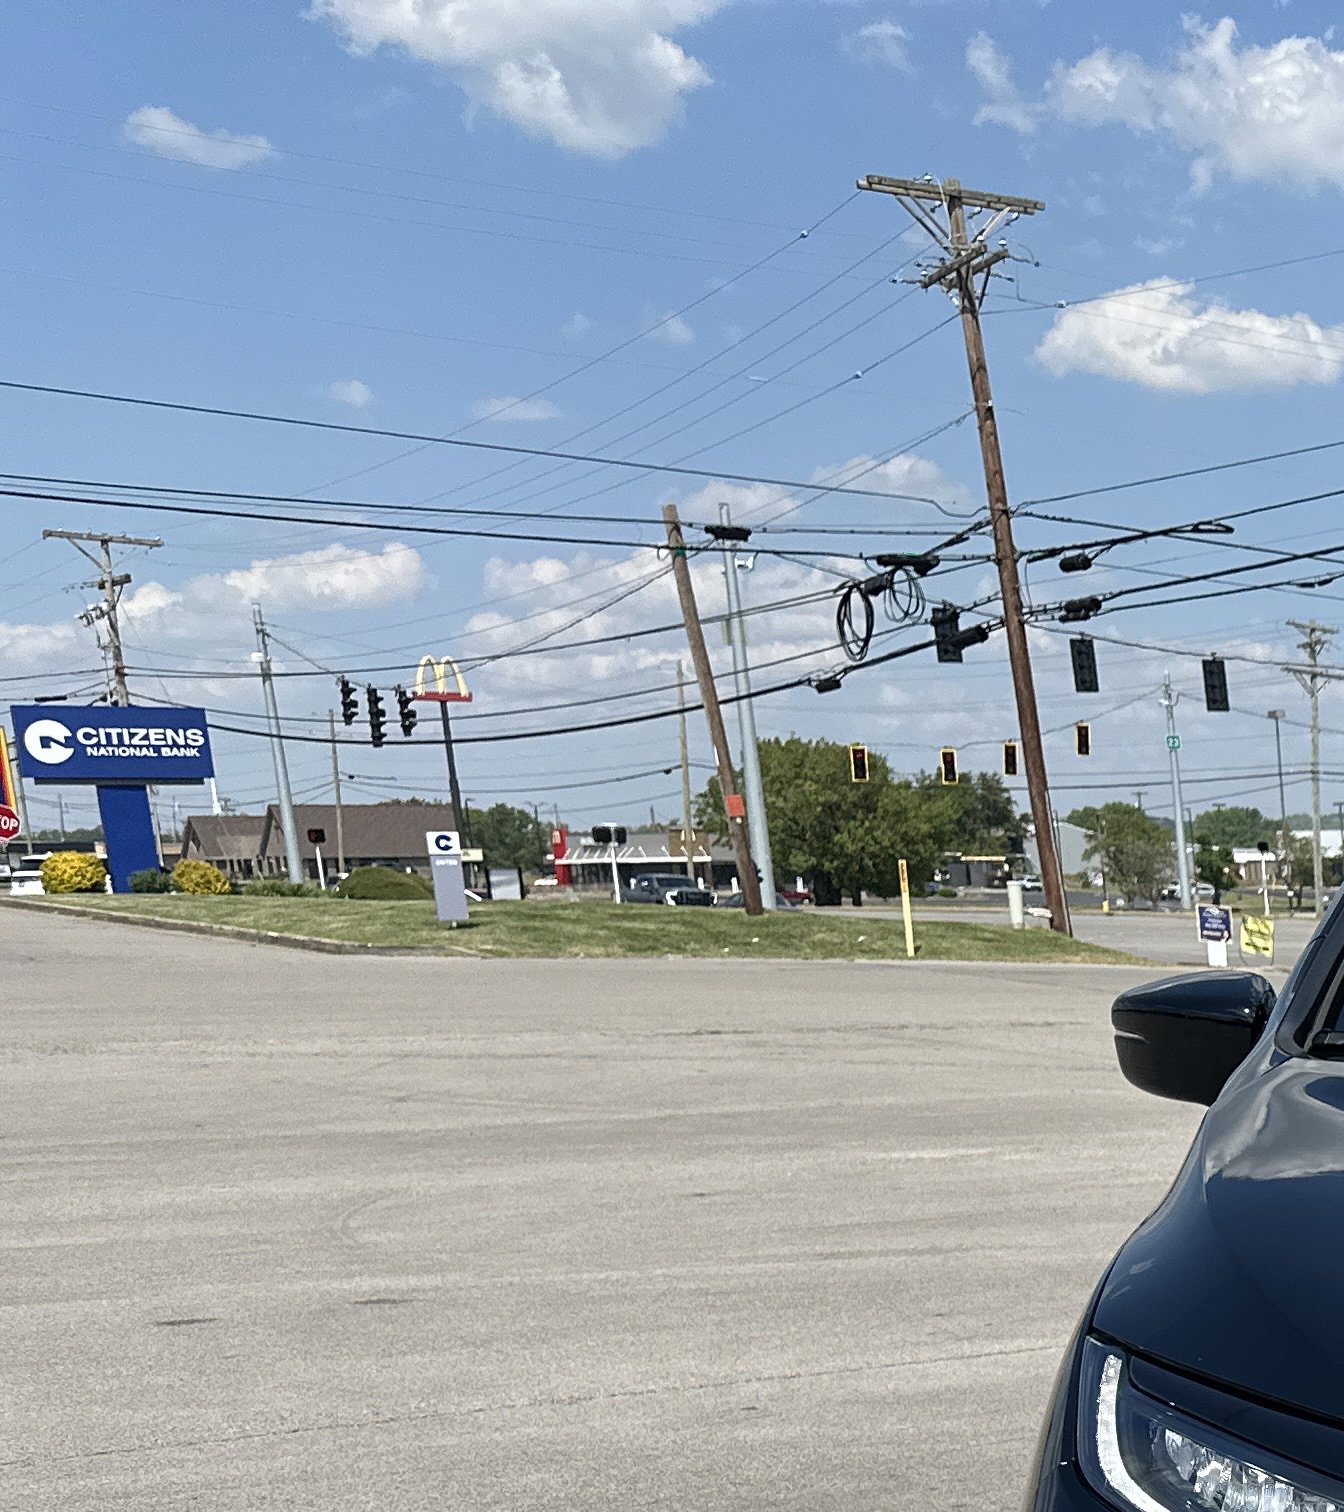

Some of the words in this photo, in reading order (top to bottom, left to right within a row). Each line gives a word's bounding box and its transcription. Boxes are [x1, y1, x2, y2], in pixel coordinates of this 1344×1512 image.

[76, 727, 204, 746] CITIZENS
[86, 747, 157, 757] NATIONAL
[161, 747, 200, 757] BANK
